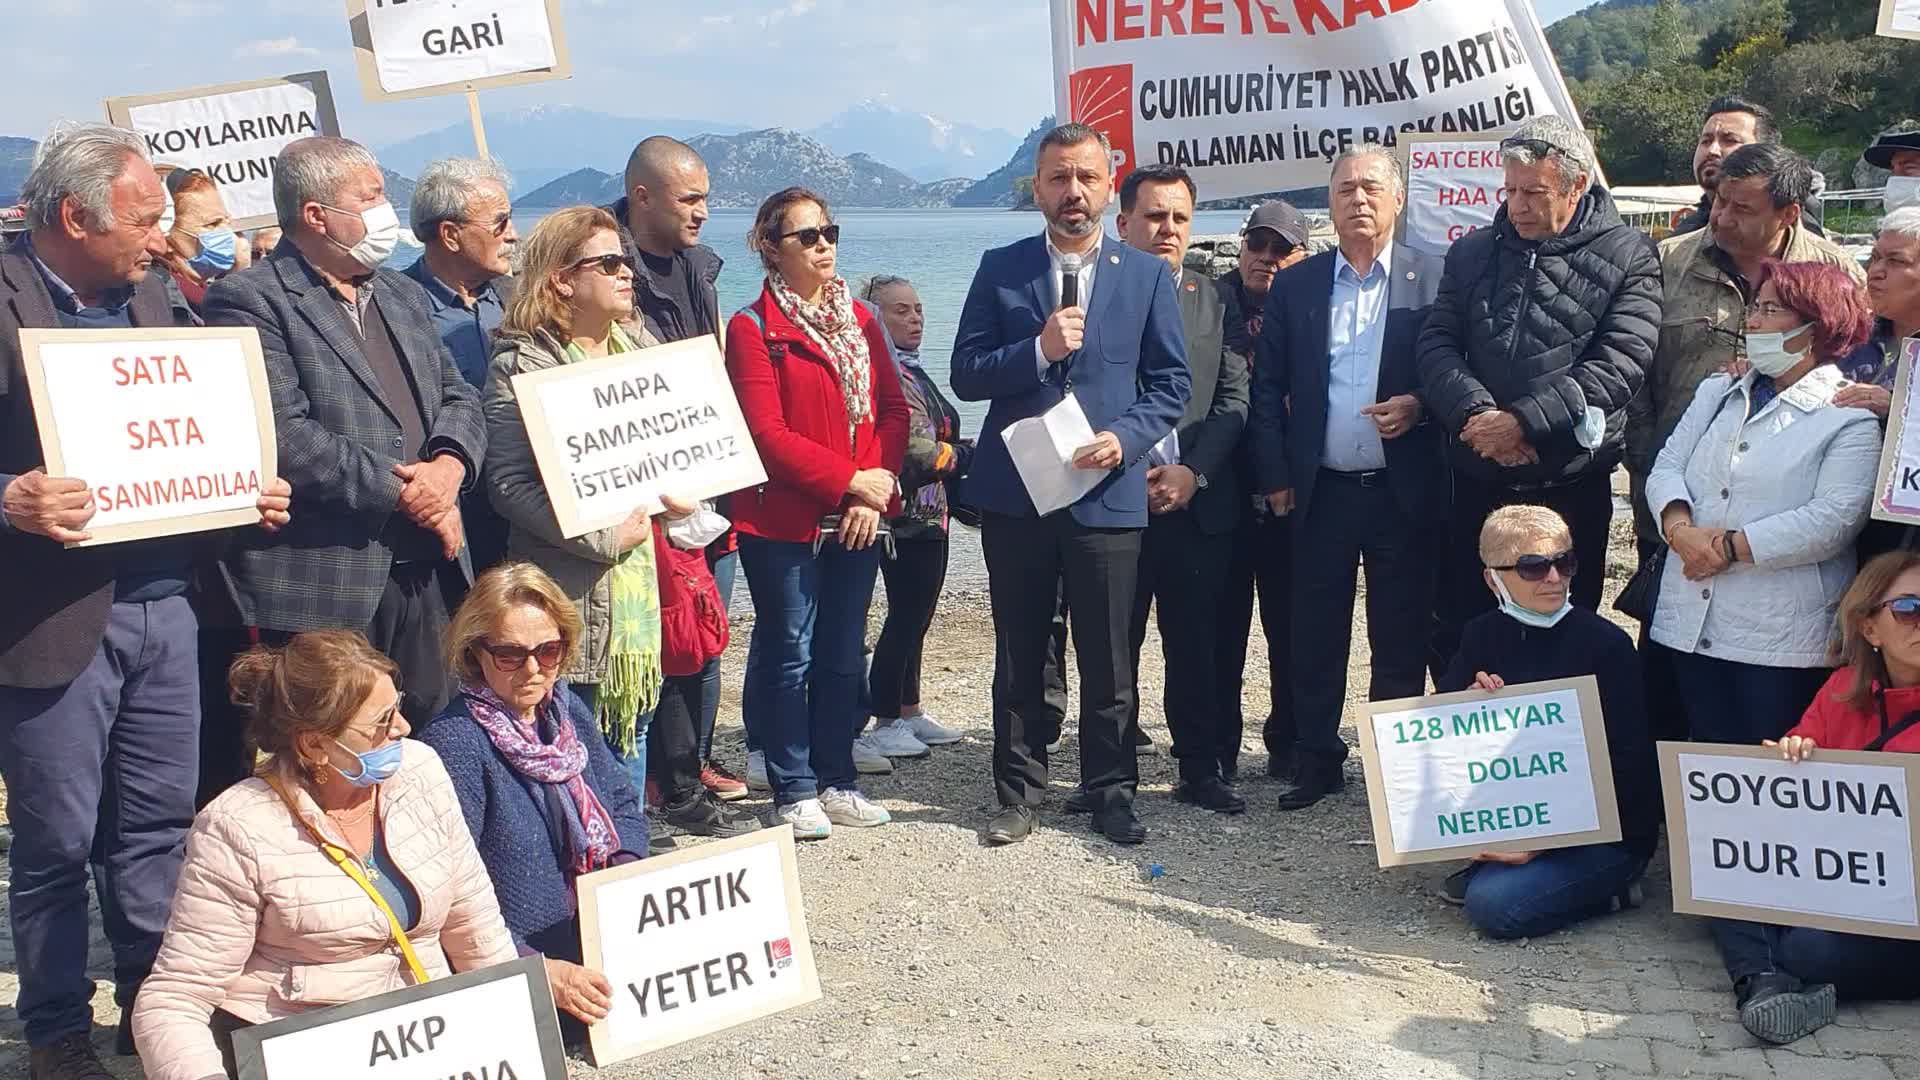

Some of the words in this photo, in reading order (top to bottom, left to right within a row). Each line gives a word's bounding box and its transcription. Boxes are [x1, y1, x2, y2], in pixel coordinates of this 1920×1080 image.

[422, 13, 504, 56] GARİ
[1139, 64, 1332, 121] CUMHURİYET
[1337, 57, 1418, 108] HALK
[144, 110, 317, 156] KOYLARIMA
[1157, 132, 1285, 168] DALAMAN
[1293, 124, 1352, 163] İLÇE
[1438, 187, 1488, 206] HAA
[112, 355, 192, 386] SATA
[593, 372, 671, 409] MAPA
[127, 416, 205, 450] SATA
[571, 436, 741, 500] İSTEMİYORUZ
[88, 469, 260, 512] SANMADILAA
[1393, 716, 1444, 744] 128
[1452, 702, 1565, 737] MİLYAR
[1467, 751, 1568, 784] DOLAR
[1688, 771, 1903, 818] SOYGUNA
[1437, 802, 1551, 836] NEREDE
[1712, 838, 1800, 878] DUR
[1815, 847, 1887, 887] DE!
[637, 868, 751, 934] ARTIK
[627, 952, 754, 1018] YETER
[369, 1015, 446, 1067] AKP
